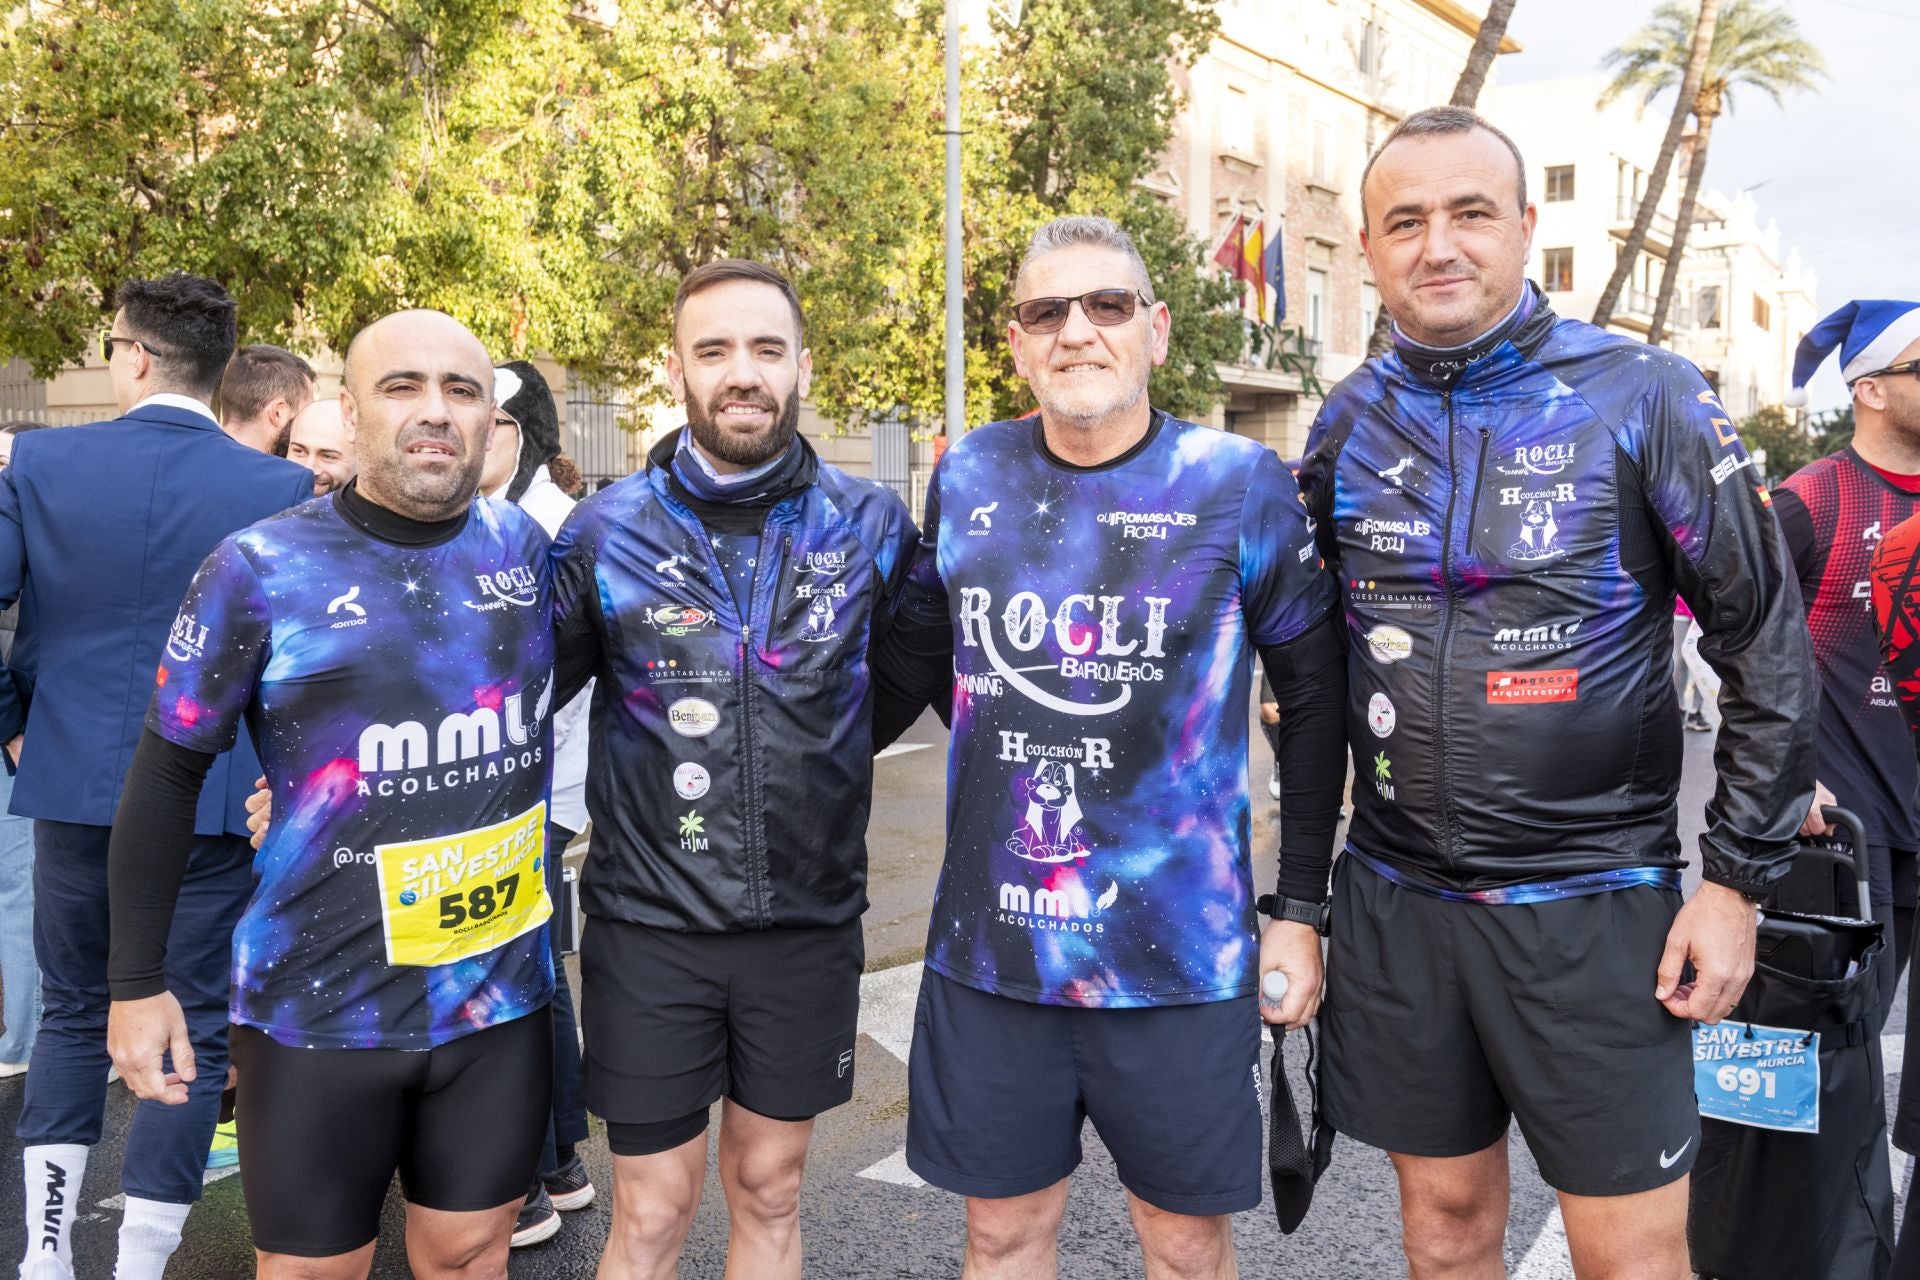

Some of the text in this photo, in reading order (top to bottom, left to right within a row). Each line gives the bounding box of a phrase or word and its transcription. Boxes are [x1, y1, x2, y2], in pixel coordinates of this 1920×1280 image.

[1514, 443, 1576, 464] ROCLI
[1097, 511, 1197, 526] QUIROMASAJES
[1355, 519, 1430, 536] QUIROMASAJES
[1124, 525, 1167, 539] ROCLI
[1370, 535, 1405, 553] ROCLI
[475, 565, 536, 597] ROCLI
[1350, 593, 1432, 602] CUESTABLANCA
[959, 587, 1172, 664] ROCLI
[1493, 642, 1572, 651] ACOLCHADOS
[648, 670, 731, 678] CUESTABLANCA
[1492, 688, 1572, 698] arquitectura
[357, 747, 542, 797] ACOLCHADOS
[402, 815, 538, 901] SILVESTRE
[402, 843, 464, 882] SAN
[494, 839, 537, 879] MURCIA
[439, 872, 520, 930] 587
[453, 926, 473, 935] ROCLI
[474, 911, 508, 929] BARQUEROS
[999, 914, 1104, 933] ACOLCHADOS
[1696, 1027, 1739, 1045] SAN
[1694, 1038, 1807, 1061] SILVESTRE
[1756, 1055, 1805, 1069] MURCIA
[1716, 1064, 1776, 1099] 691
[42, 1160, 66, 1252] MAVIC
